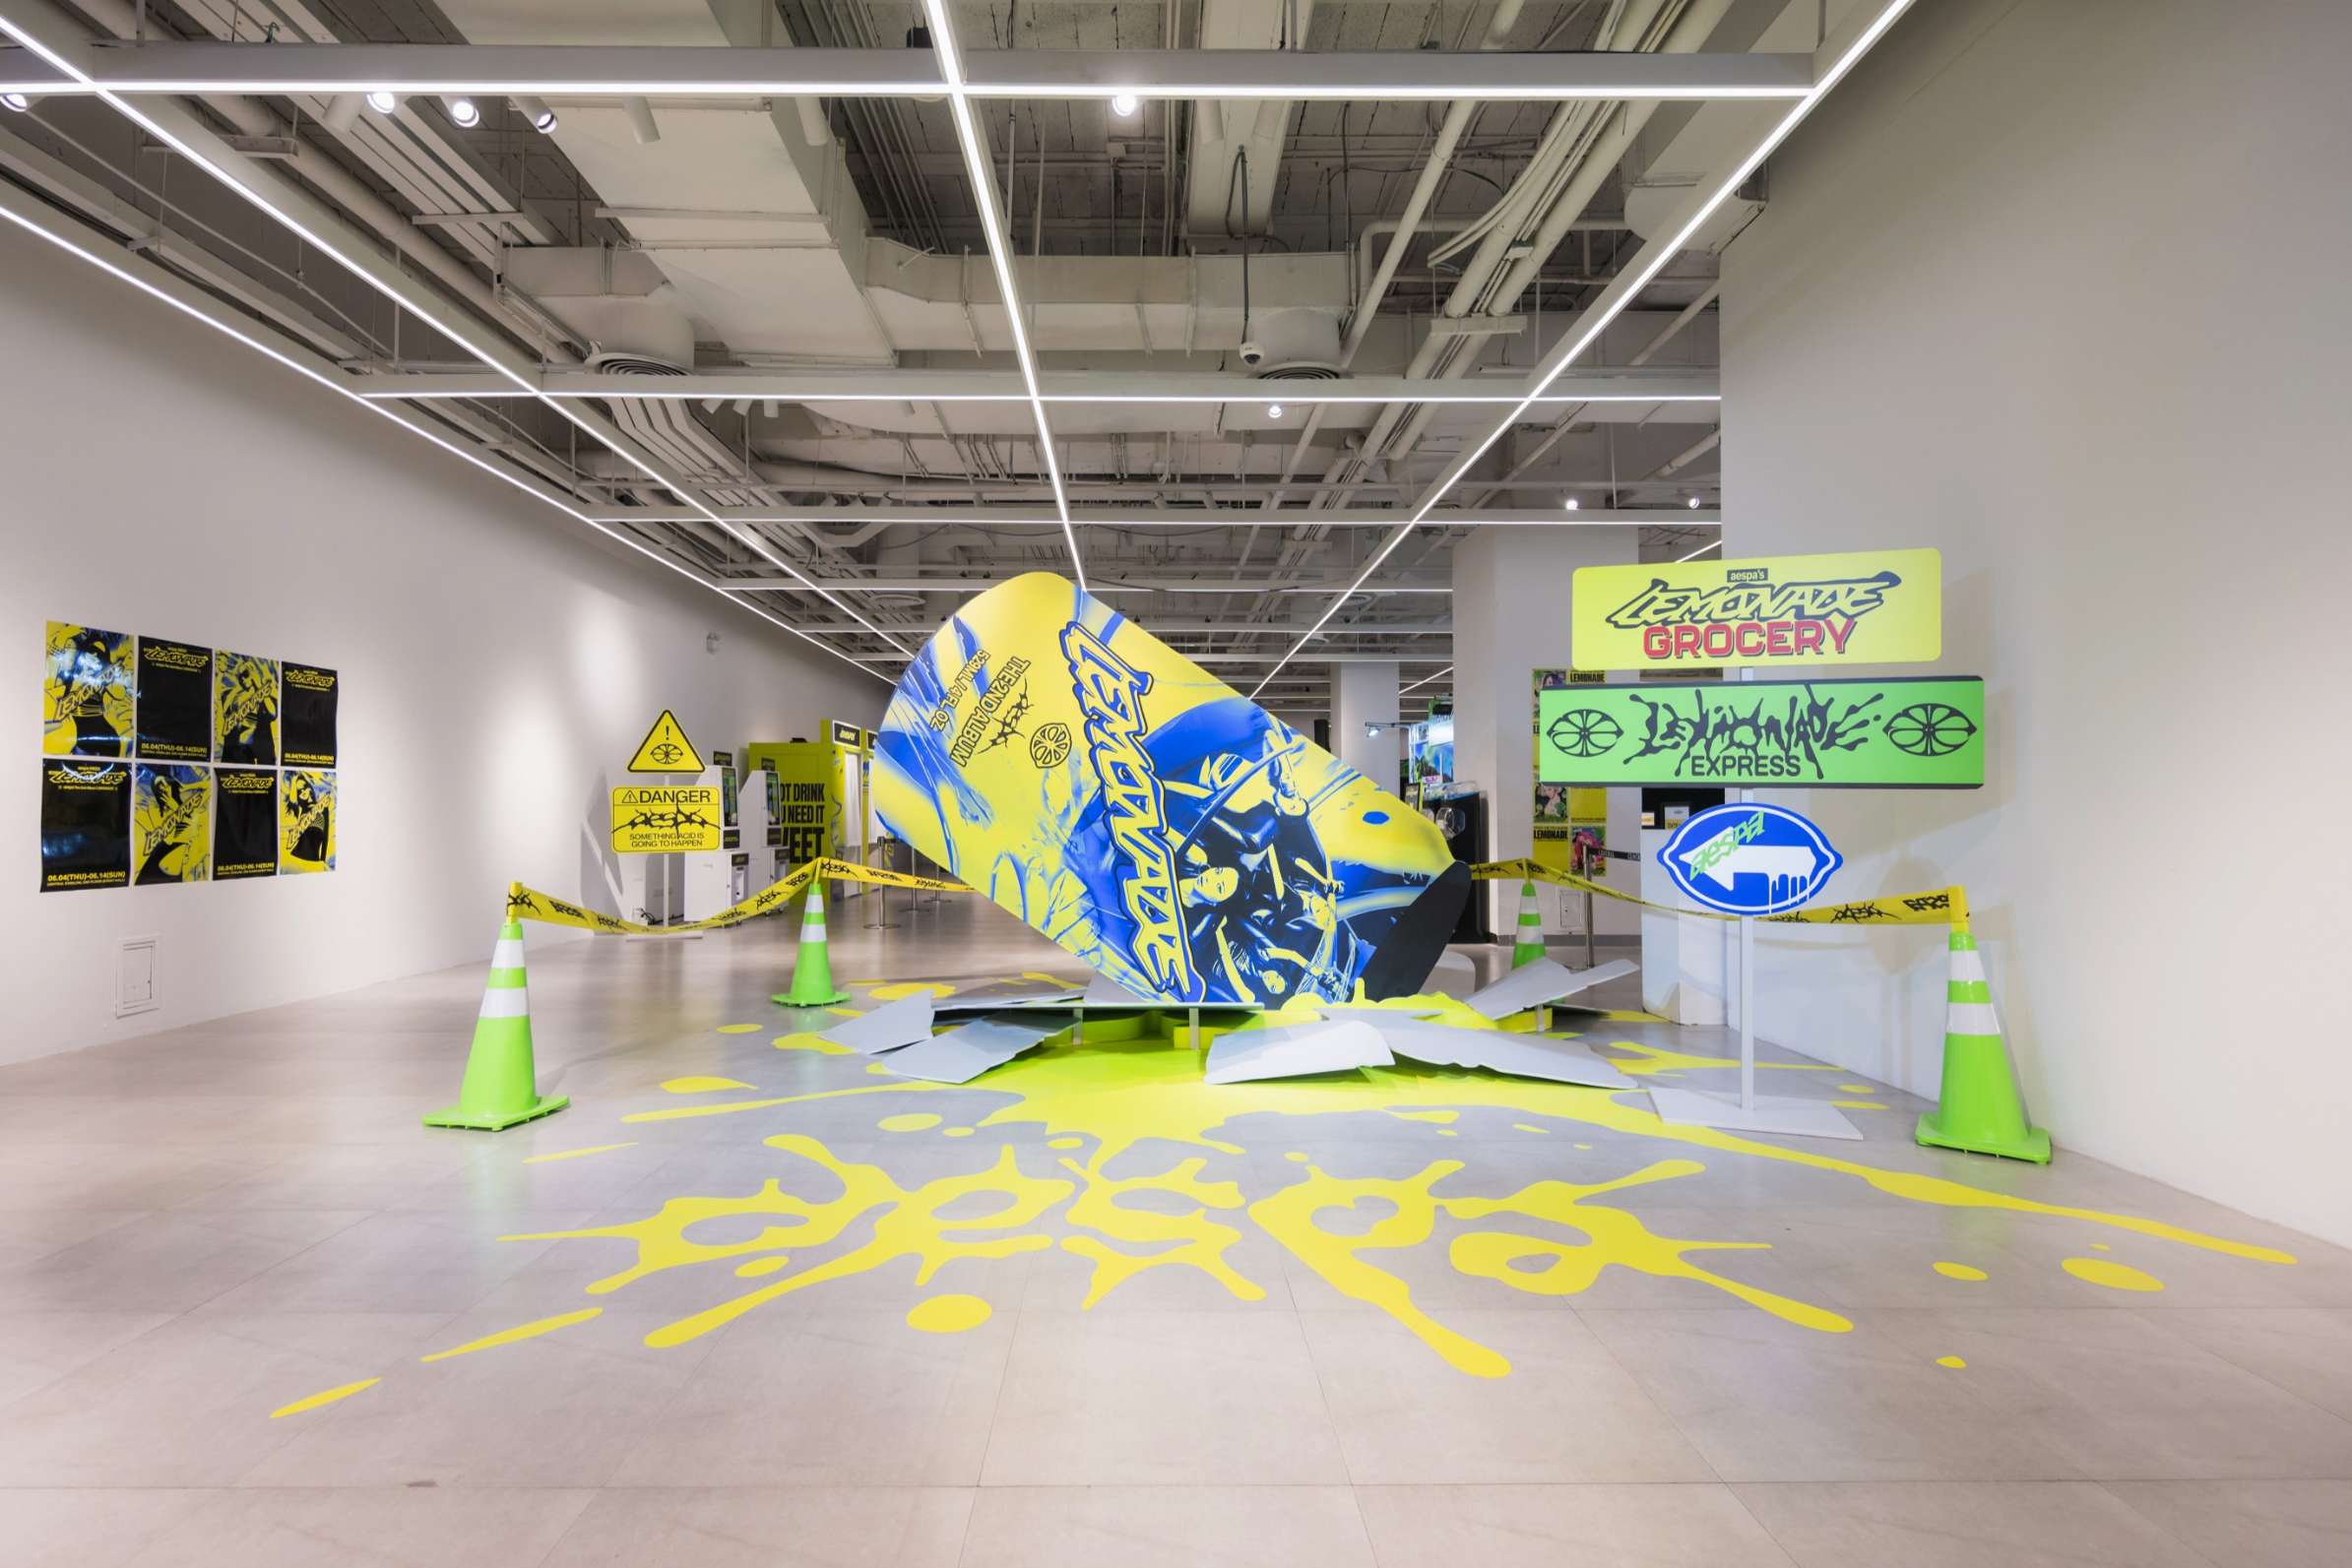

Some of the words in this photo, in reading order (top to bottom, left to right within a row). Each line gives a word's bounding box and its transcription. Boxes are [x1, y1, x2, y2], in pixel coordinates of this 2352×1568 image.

[1730, 569, 1765, 582] aespa's
[1605, 571, 1902, 628] LEMONADE
[1643, 617, 1858, 659] GROCERY
[997, 657, 1031, 687] THE
[980, 678, 1010, 715] 2ND
[949, 707, 990, 768] ALBUM
[1690, 755, 1802, 778] EXPRESS
[639, 789, 711, 803] DANGER
[795, 784, 825, 802] DRINK
[789, 804, 812, 824] NEED
[815, 804, 824, 824] IT
[1058, 621, 1207, 1004] LEMONADE
